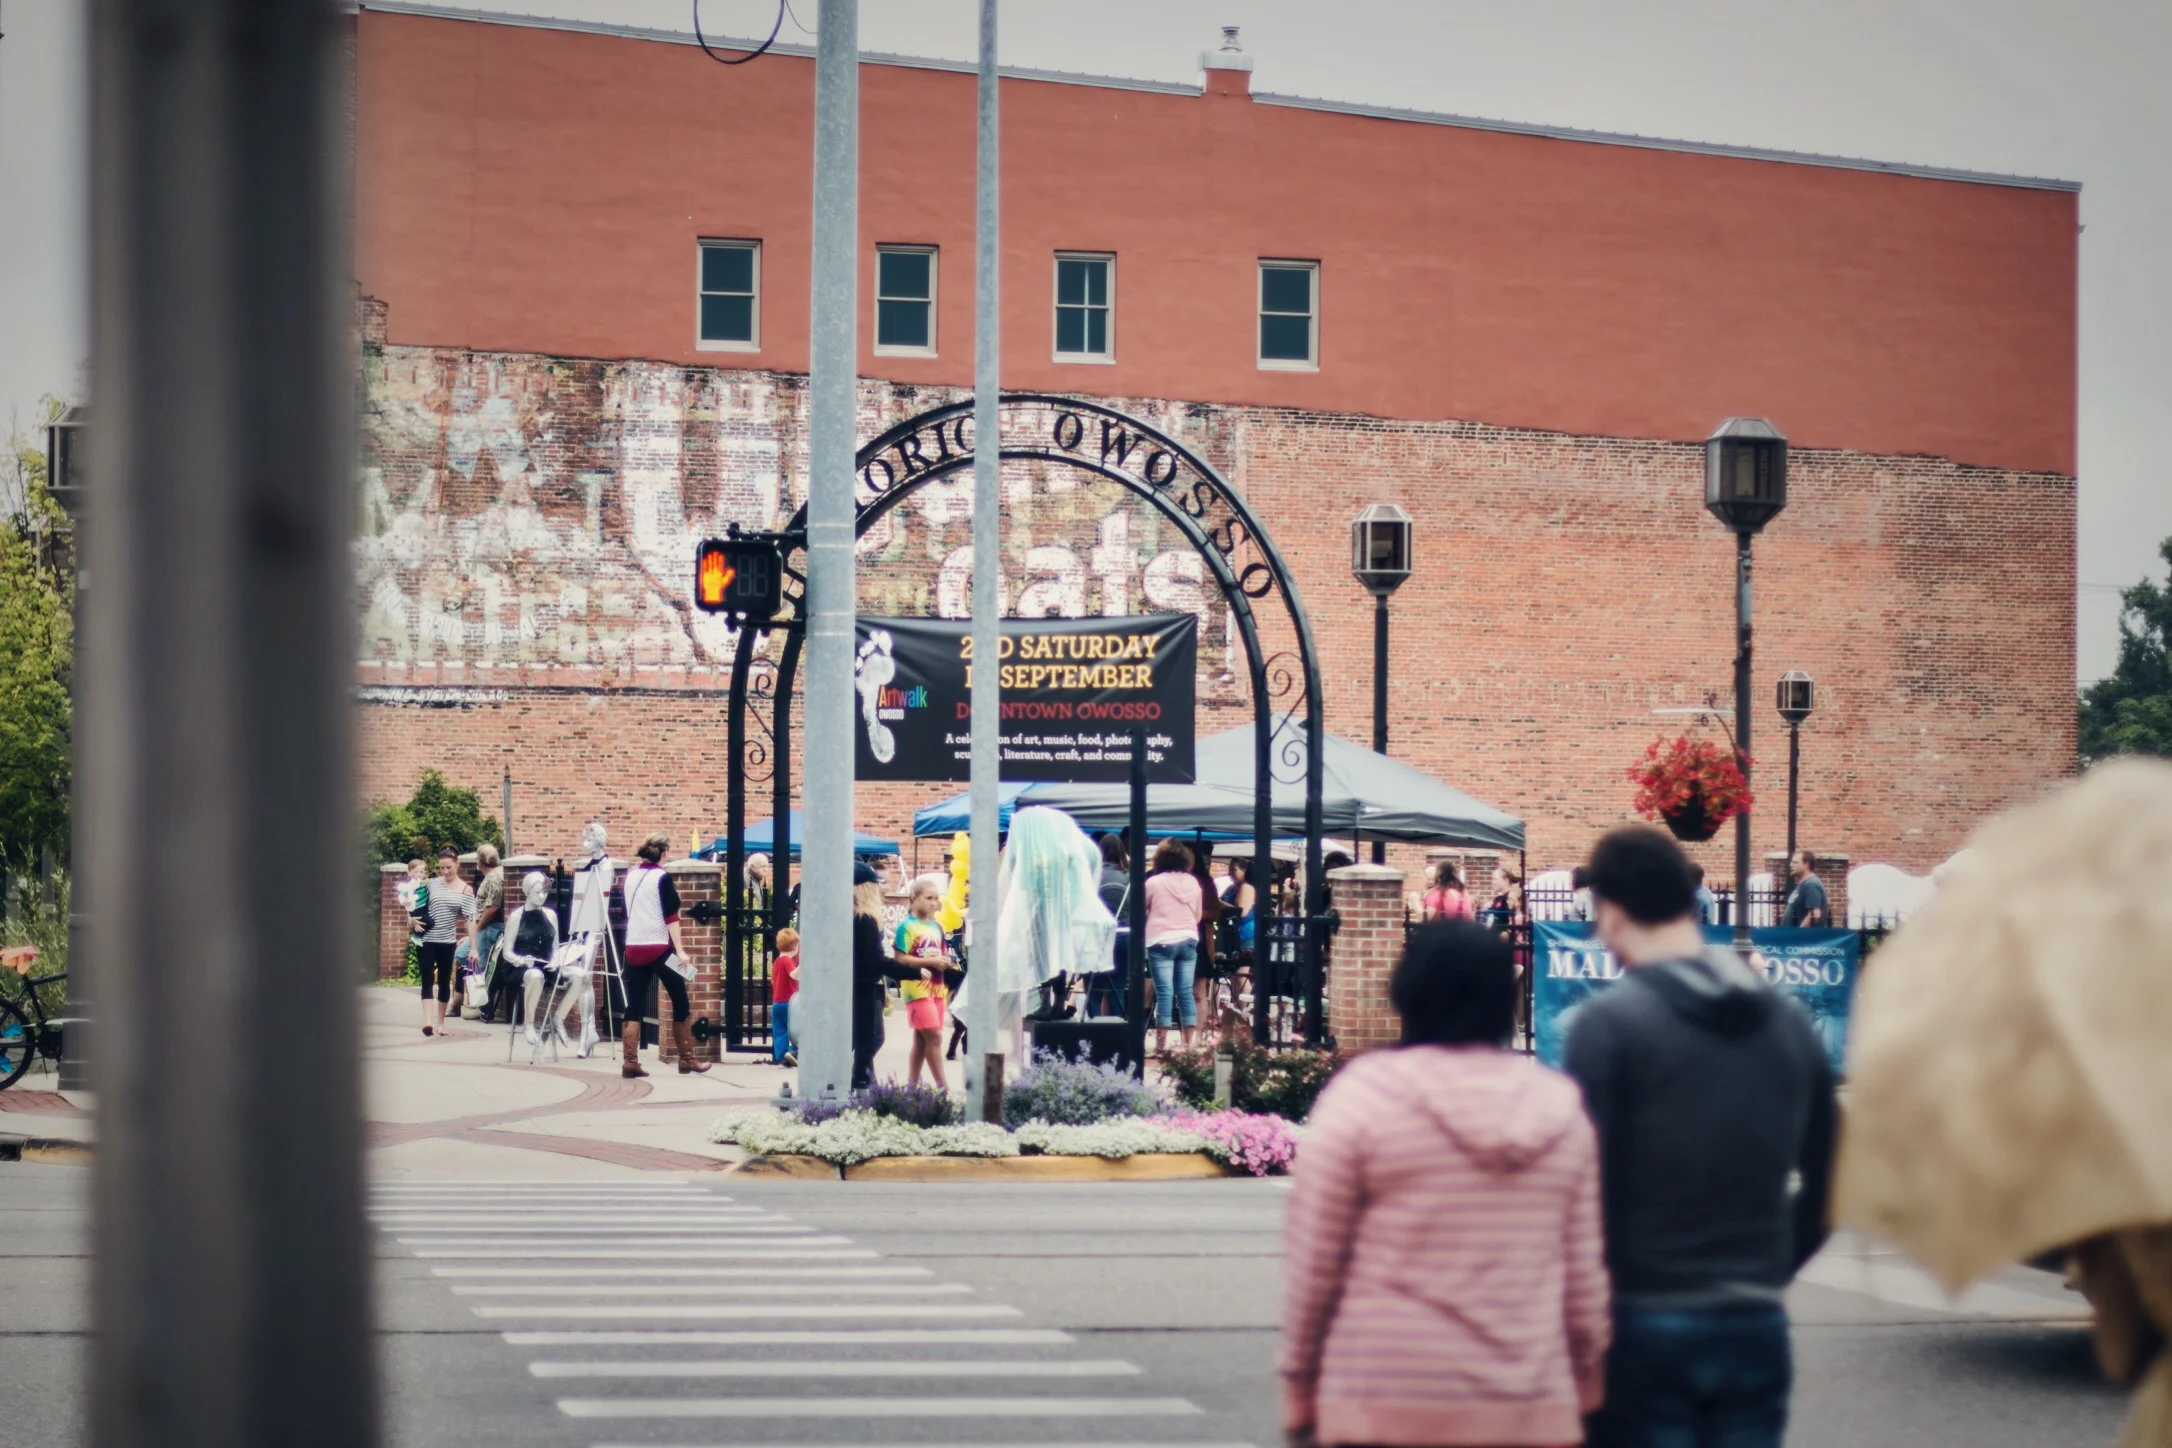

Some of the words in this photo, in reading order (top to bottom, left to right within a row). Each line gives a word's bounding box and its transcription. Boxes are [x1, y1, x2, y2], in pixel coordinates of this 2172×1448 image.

[1053, 411, 1273, 598] OWOSSO
[960, 635, 1014, 659] 2D
[1019, 635, 1160, 659] SATURDAY
[1000, 664, 1153, 688] SEPTEMBER
[879, 684, 928, 708] Artwalk
[879, 708, 905, 720] OWOSSO
[956, 702, 1072, 719] DNTOWN
[1076, 702, 1162, 719] OWOSSO
[945, 733, 954, 744] A
[1012, 733, 1023, 744] of
[1024, 734, 1042, 746] art,
[1043, 734, 1076, 746] music,
[1078, 733, 1103, 746] food,
[1004, 748, 1054, 761] literature,
[1055, 749, 1082, 761] craft,
[1083, 749, 1103, 760] and
[1104, 750, 1164, 763] commity.
[1785, 946, 1845, 956] COMMISSION
[1765, 957, 1844, 986] OSSO
